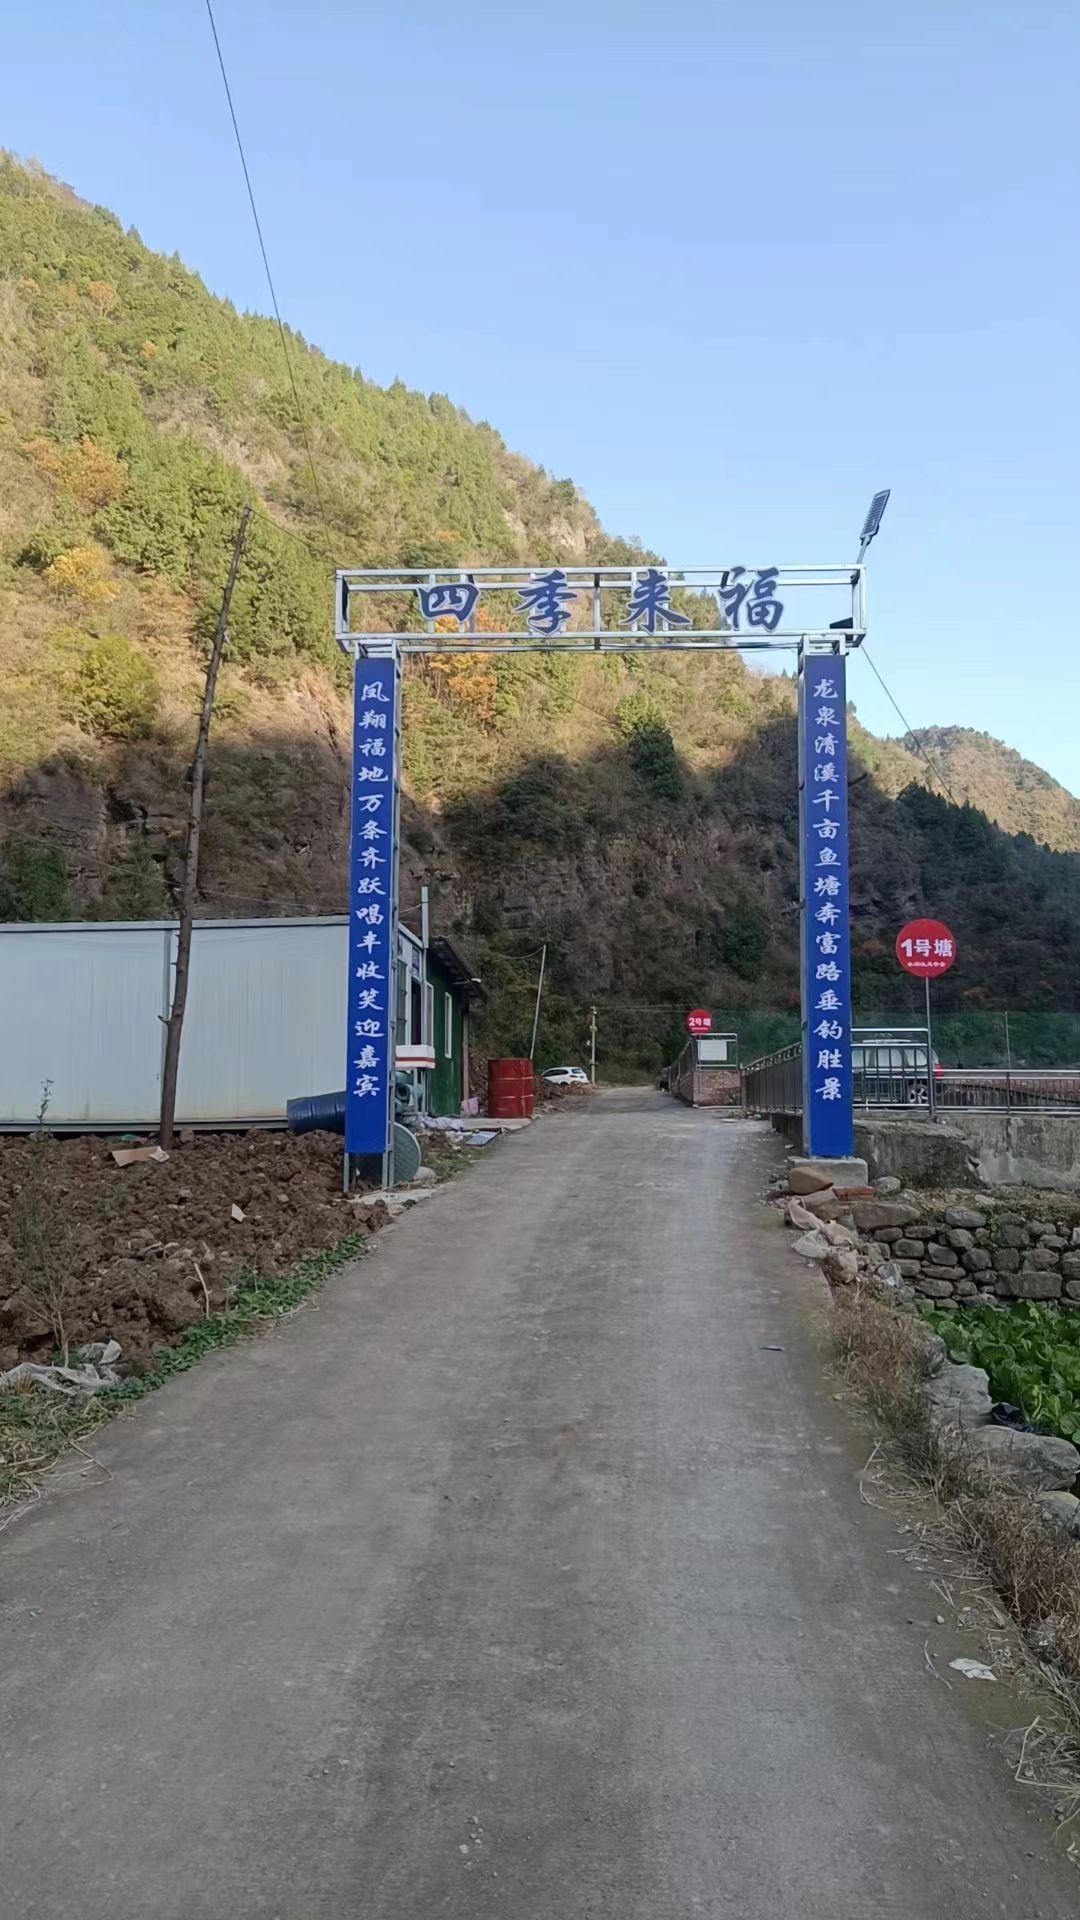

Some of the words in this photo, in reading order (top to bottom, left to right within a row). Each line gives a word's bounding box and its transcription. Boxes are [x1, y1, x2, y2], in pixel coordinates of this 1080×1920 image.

[418, 567, 784, 634] 四季来福
[353, 680, 390, 1097] 凤翔福地万条齐跃唱丰收笑迎嘉宾
[812, 678, 844, 1100] 龙泉清溪千亩鱼塘奔富路垂钓胜景
[901, 938, 953, 957] 1号塘
